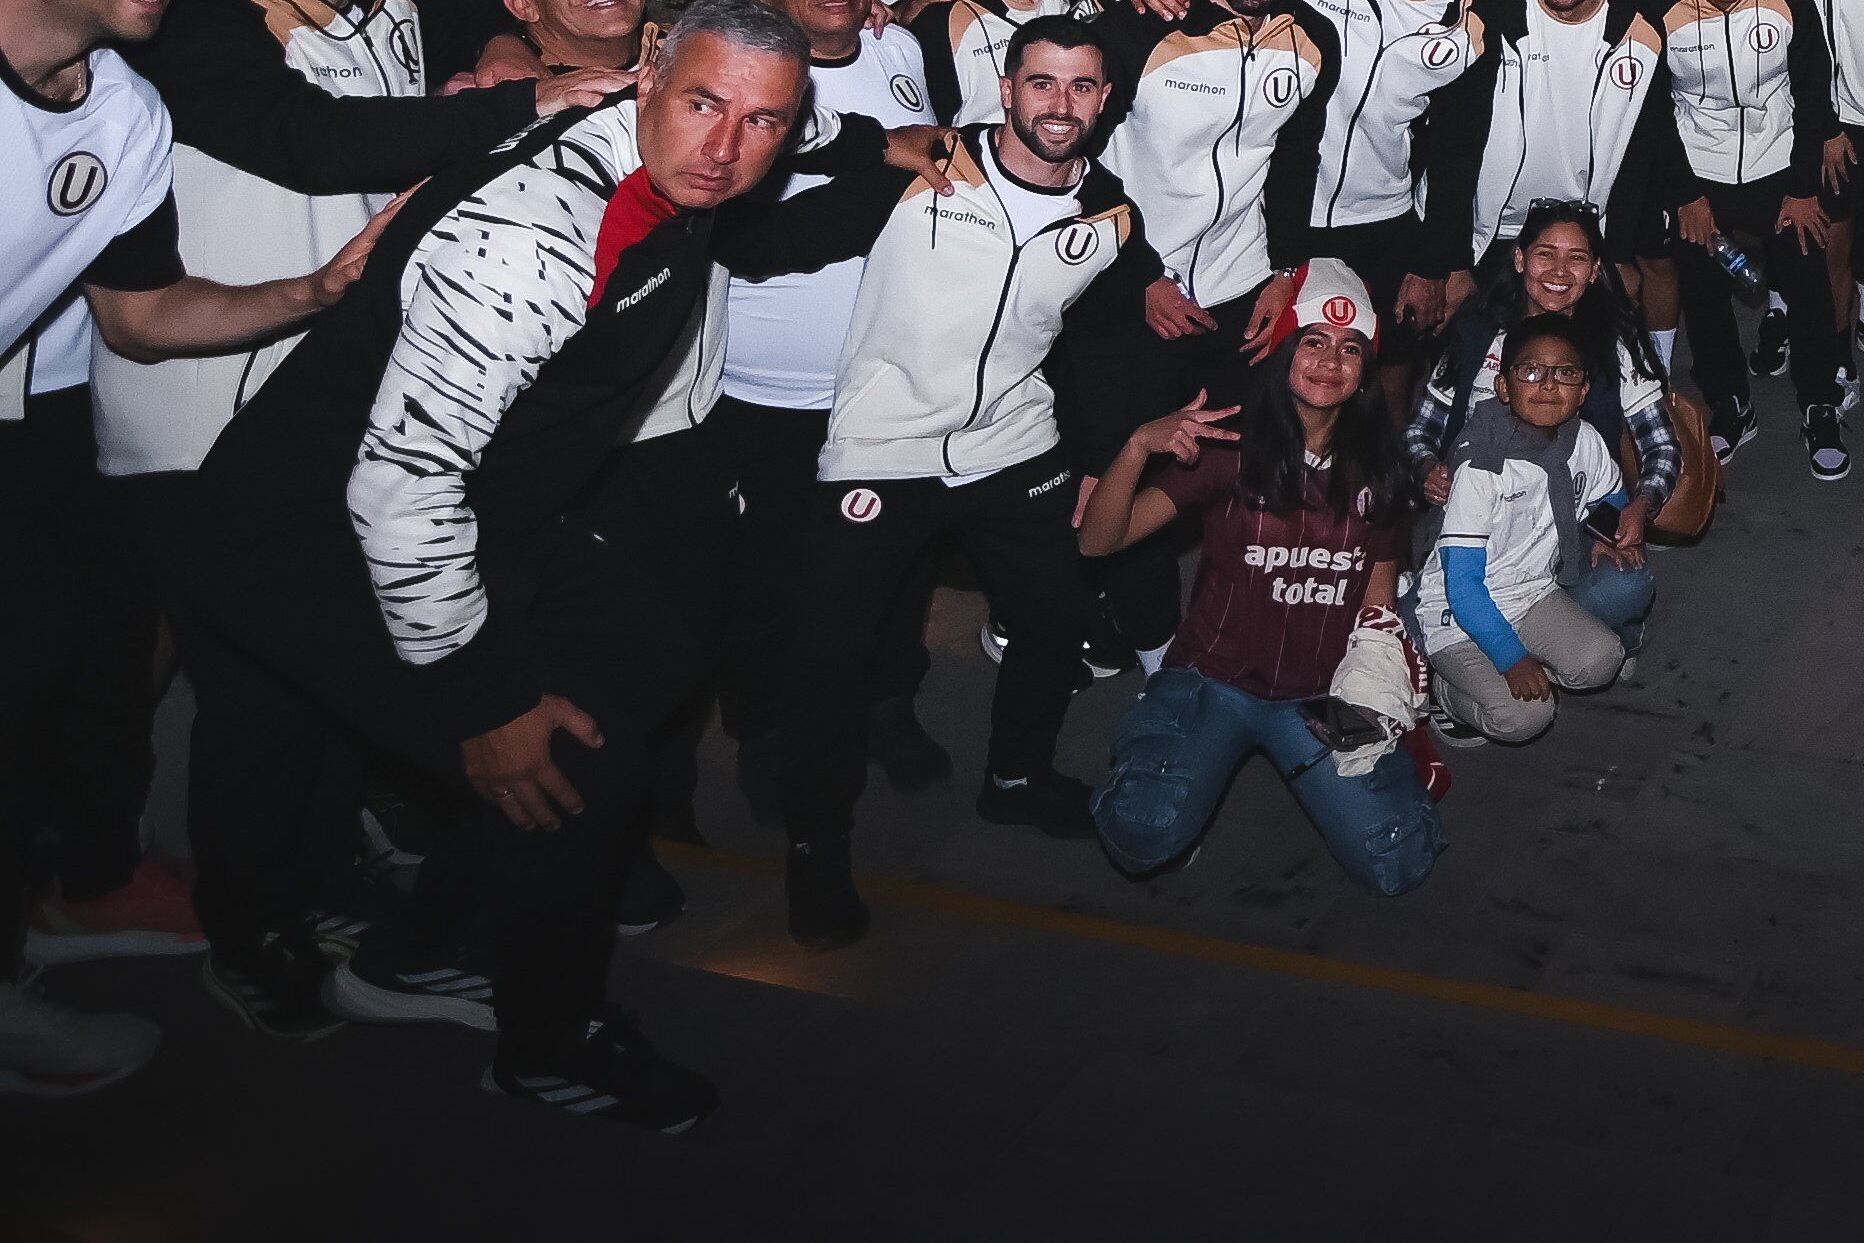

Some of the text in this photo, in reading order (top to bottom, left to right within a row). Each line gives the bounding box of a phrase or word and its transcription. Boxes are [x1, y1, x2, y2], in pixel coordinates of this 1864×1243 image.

[1164, 76, 1227, 97] marathon
[923, 203, 997, 231] marathon
[615, 266, 672, 313] marathon
[1271, 576, 1348, 607] total
